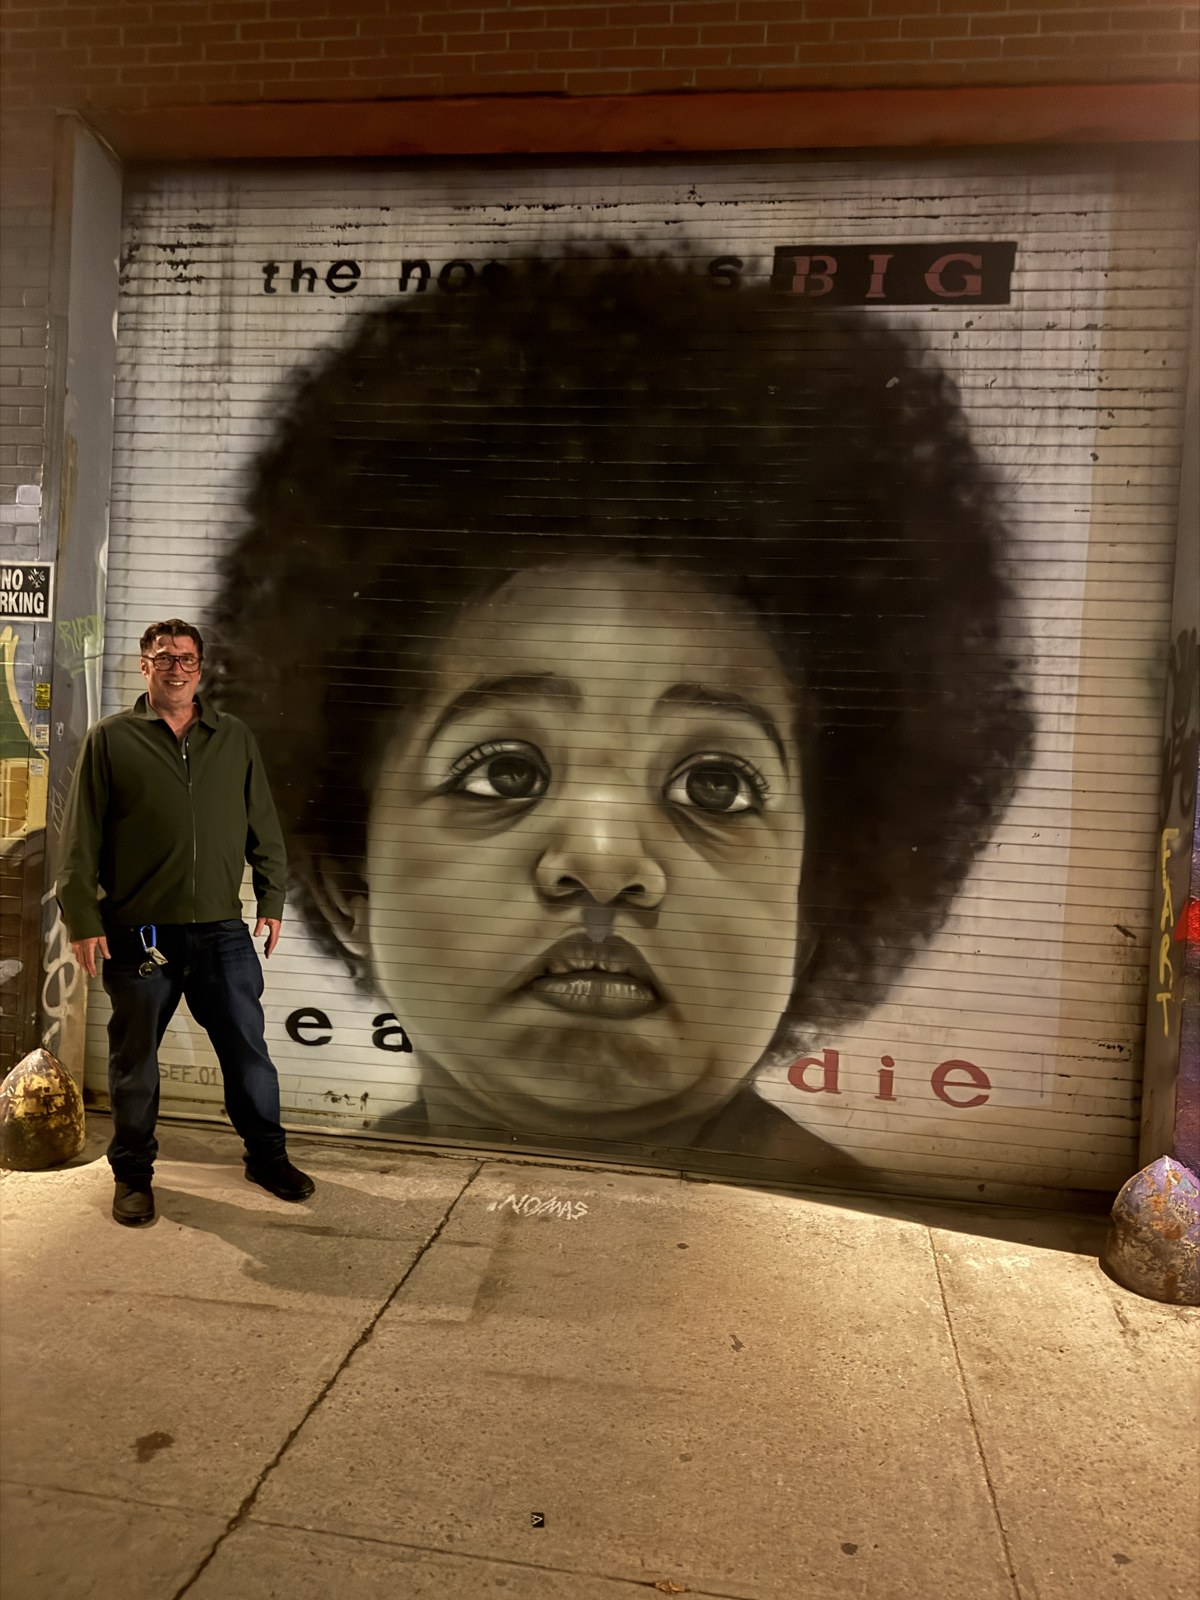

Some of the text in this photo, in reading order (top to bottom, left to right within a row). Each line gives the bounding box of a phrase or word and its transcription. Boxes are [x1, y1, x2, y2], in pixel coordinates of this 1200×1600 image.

[262, 258, 361, 295] the
[791, 252, 983, 299] BIG
[1, 568, 24, 591] NO
[0, 592, 45, 615] RKING
[787, 1048, 992, 1109] die
